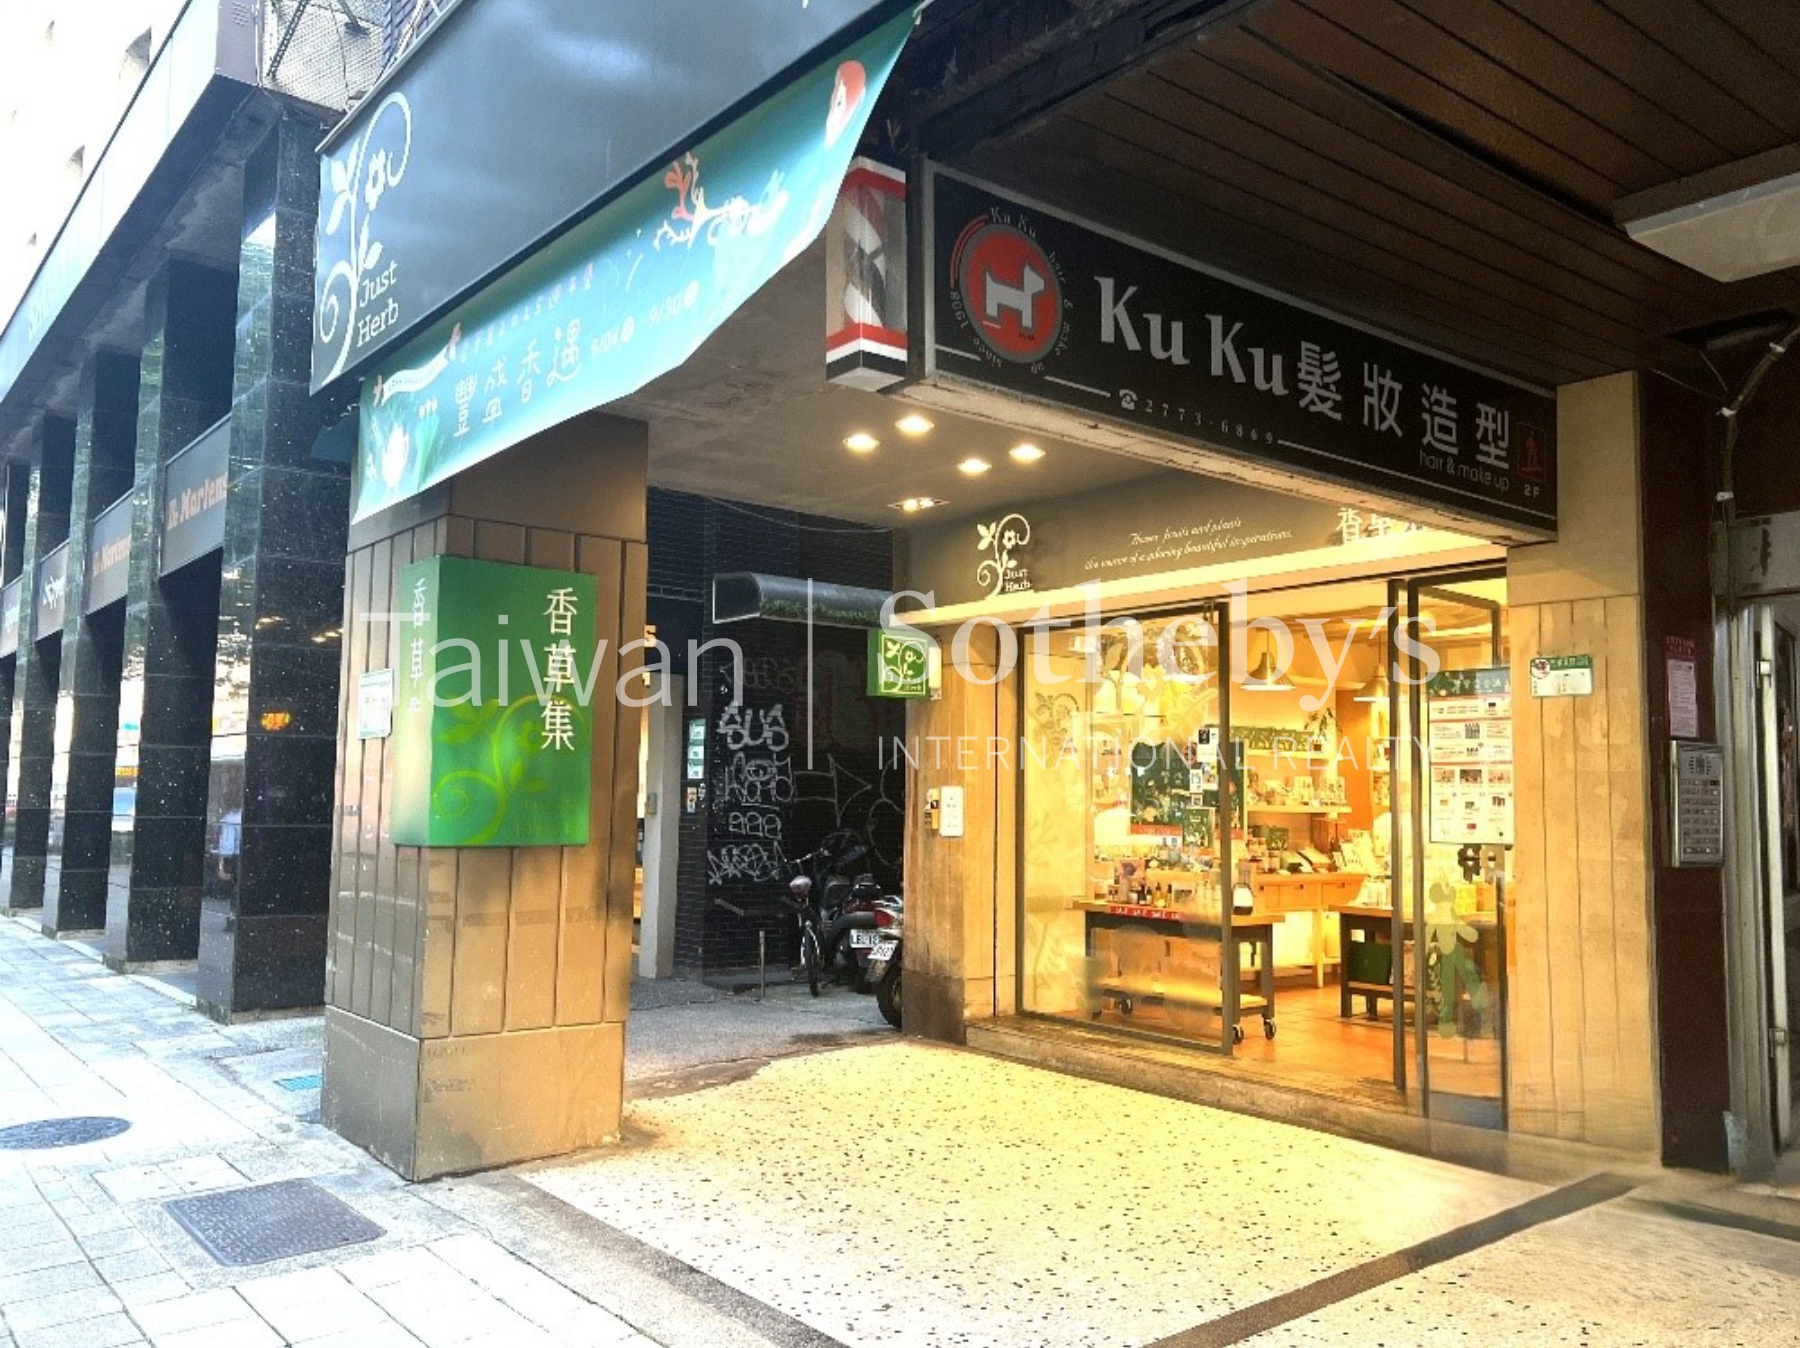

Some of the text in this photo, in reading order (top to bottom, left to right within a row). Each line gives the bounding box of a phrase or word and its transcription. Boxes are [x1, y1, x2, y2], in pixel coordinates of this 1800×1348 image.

[359, 263, 398, 309] Just
[356, 299, 399, 348] Herb
[1094, 275, 1190, 366] Ku
[1204, 314, 1290, 397] Ku
[1420, 449, 1443, 471] hair
[1447, 456, 1456, 475] &
[1524, 484, 1540, 499] 2F
[1005, 579, 1032, 592] Herb
[540, 587, 578, 752] 香草集
